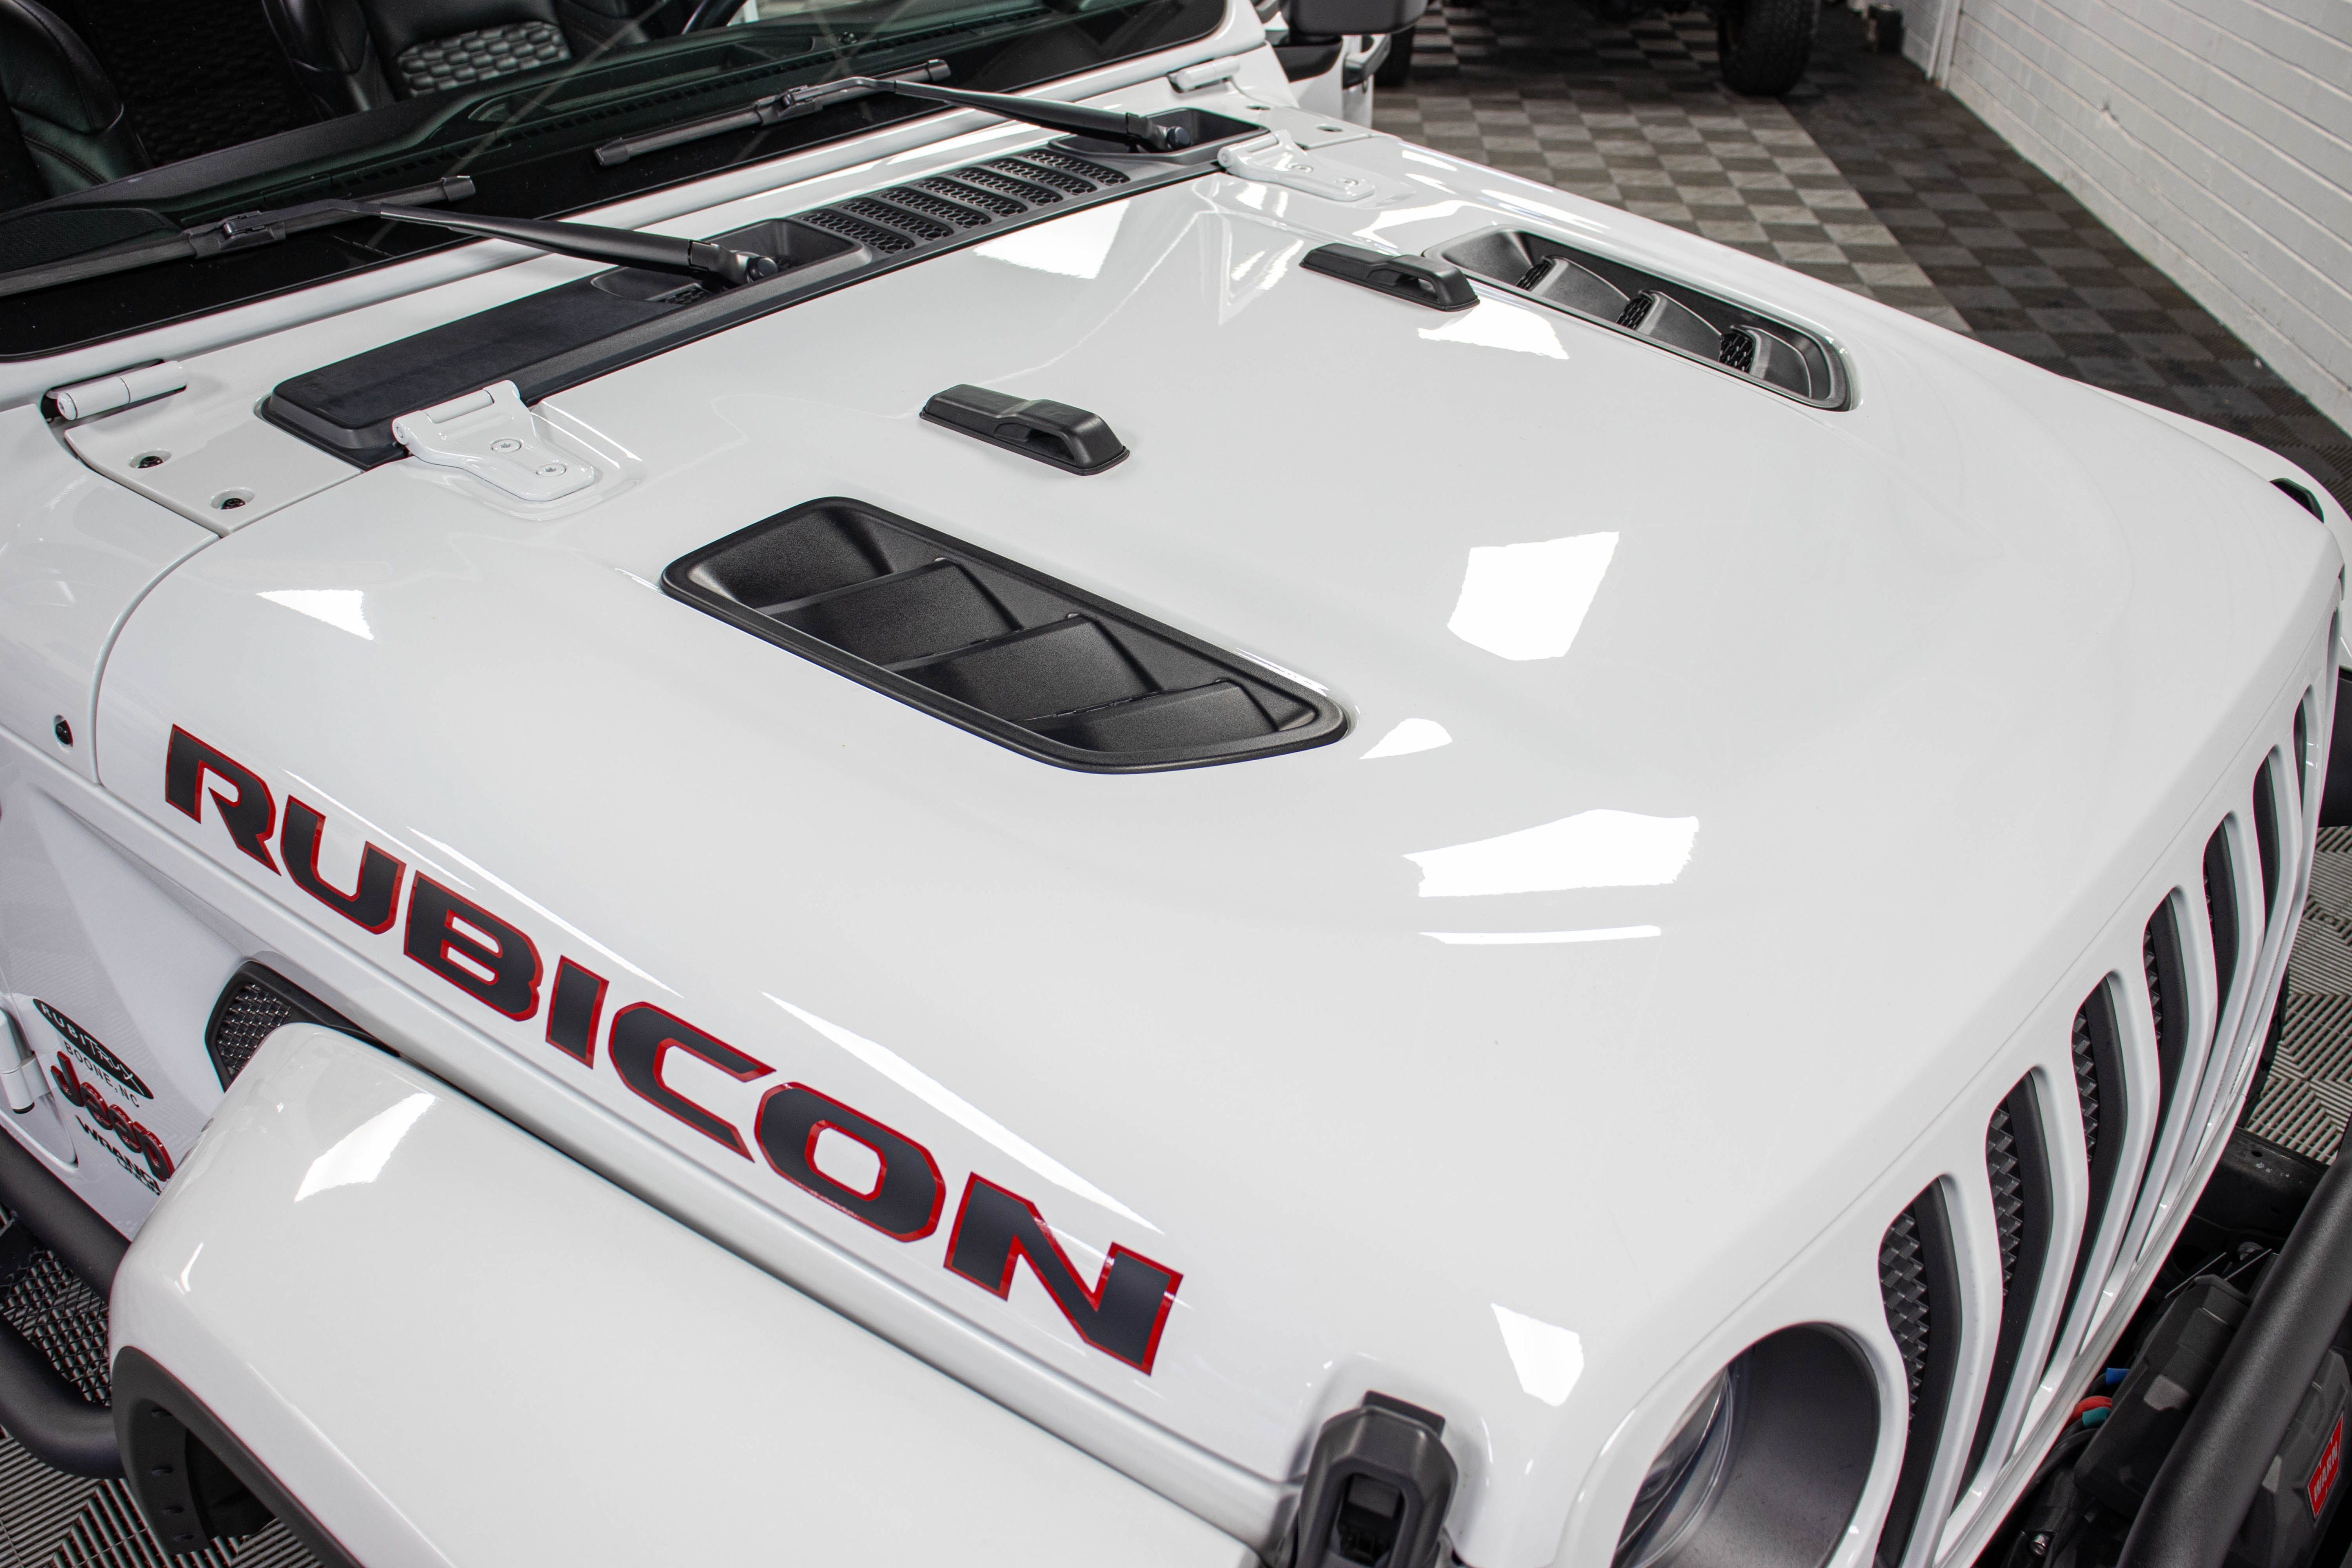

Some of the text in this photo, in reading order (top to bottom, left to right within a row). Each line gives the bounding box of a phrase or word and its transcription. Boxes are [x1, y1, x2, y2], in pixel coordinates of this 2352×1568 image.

[64, 1040, 139, 1107] BOONE, NC
[165, 723, 1184, 1376] RUBICON
[51, 1051, 175, 1181] Jeep
[2314, 1441, 2337, 1502] WARN
